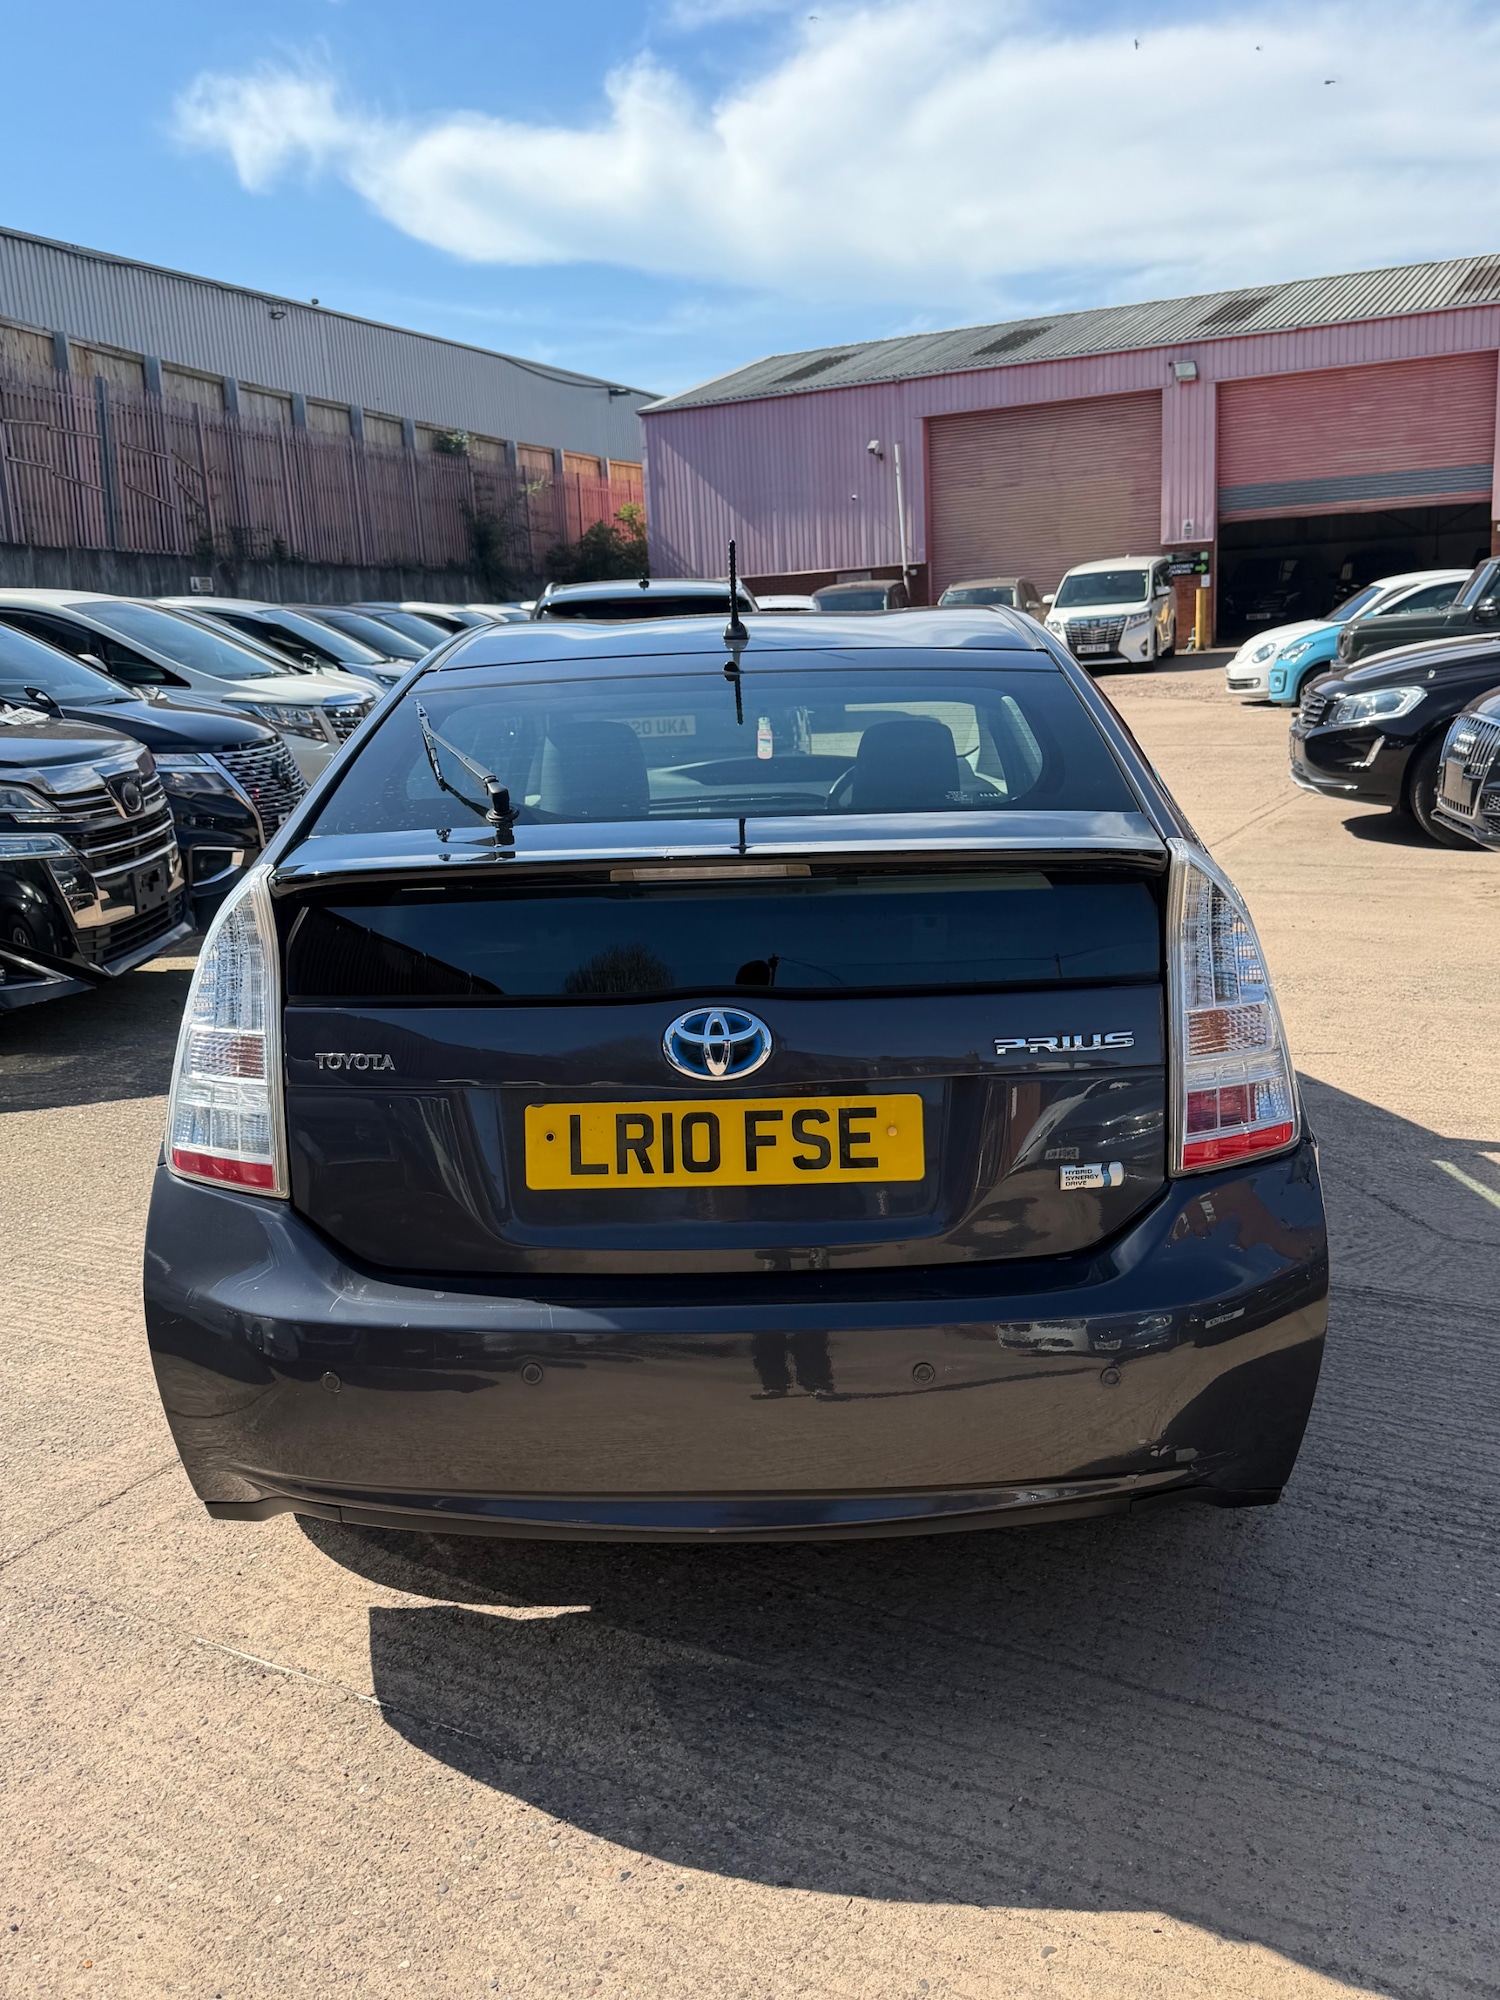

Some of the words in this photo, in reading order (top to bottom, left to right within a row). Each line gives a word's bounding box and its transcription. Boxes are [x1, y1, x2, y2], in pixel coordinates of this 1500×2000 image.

[622, 720, 652, 735] 20
[656, 718, 689, 734] UKA
[994, 1031, 1135, 1055] PRIUS
[315, 1053, 395, 1070] TOYOTA
[569, 1111, 721, 1175] LR10
[744, 1107, 879, 1172] FSE
[1065, 1168, 1093, 1176] HYBRID
[1065, 1174, 1100, 1182] SYNERGY
